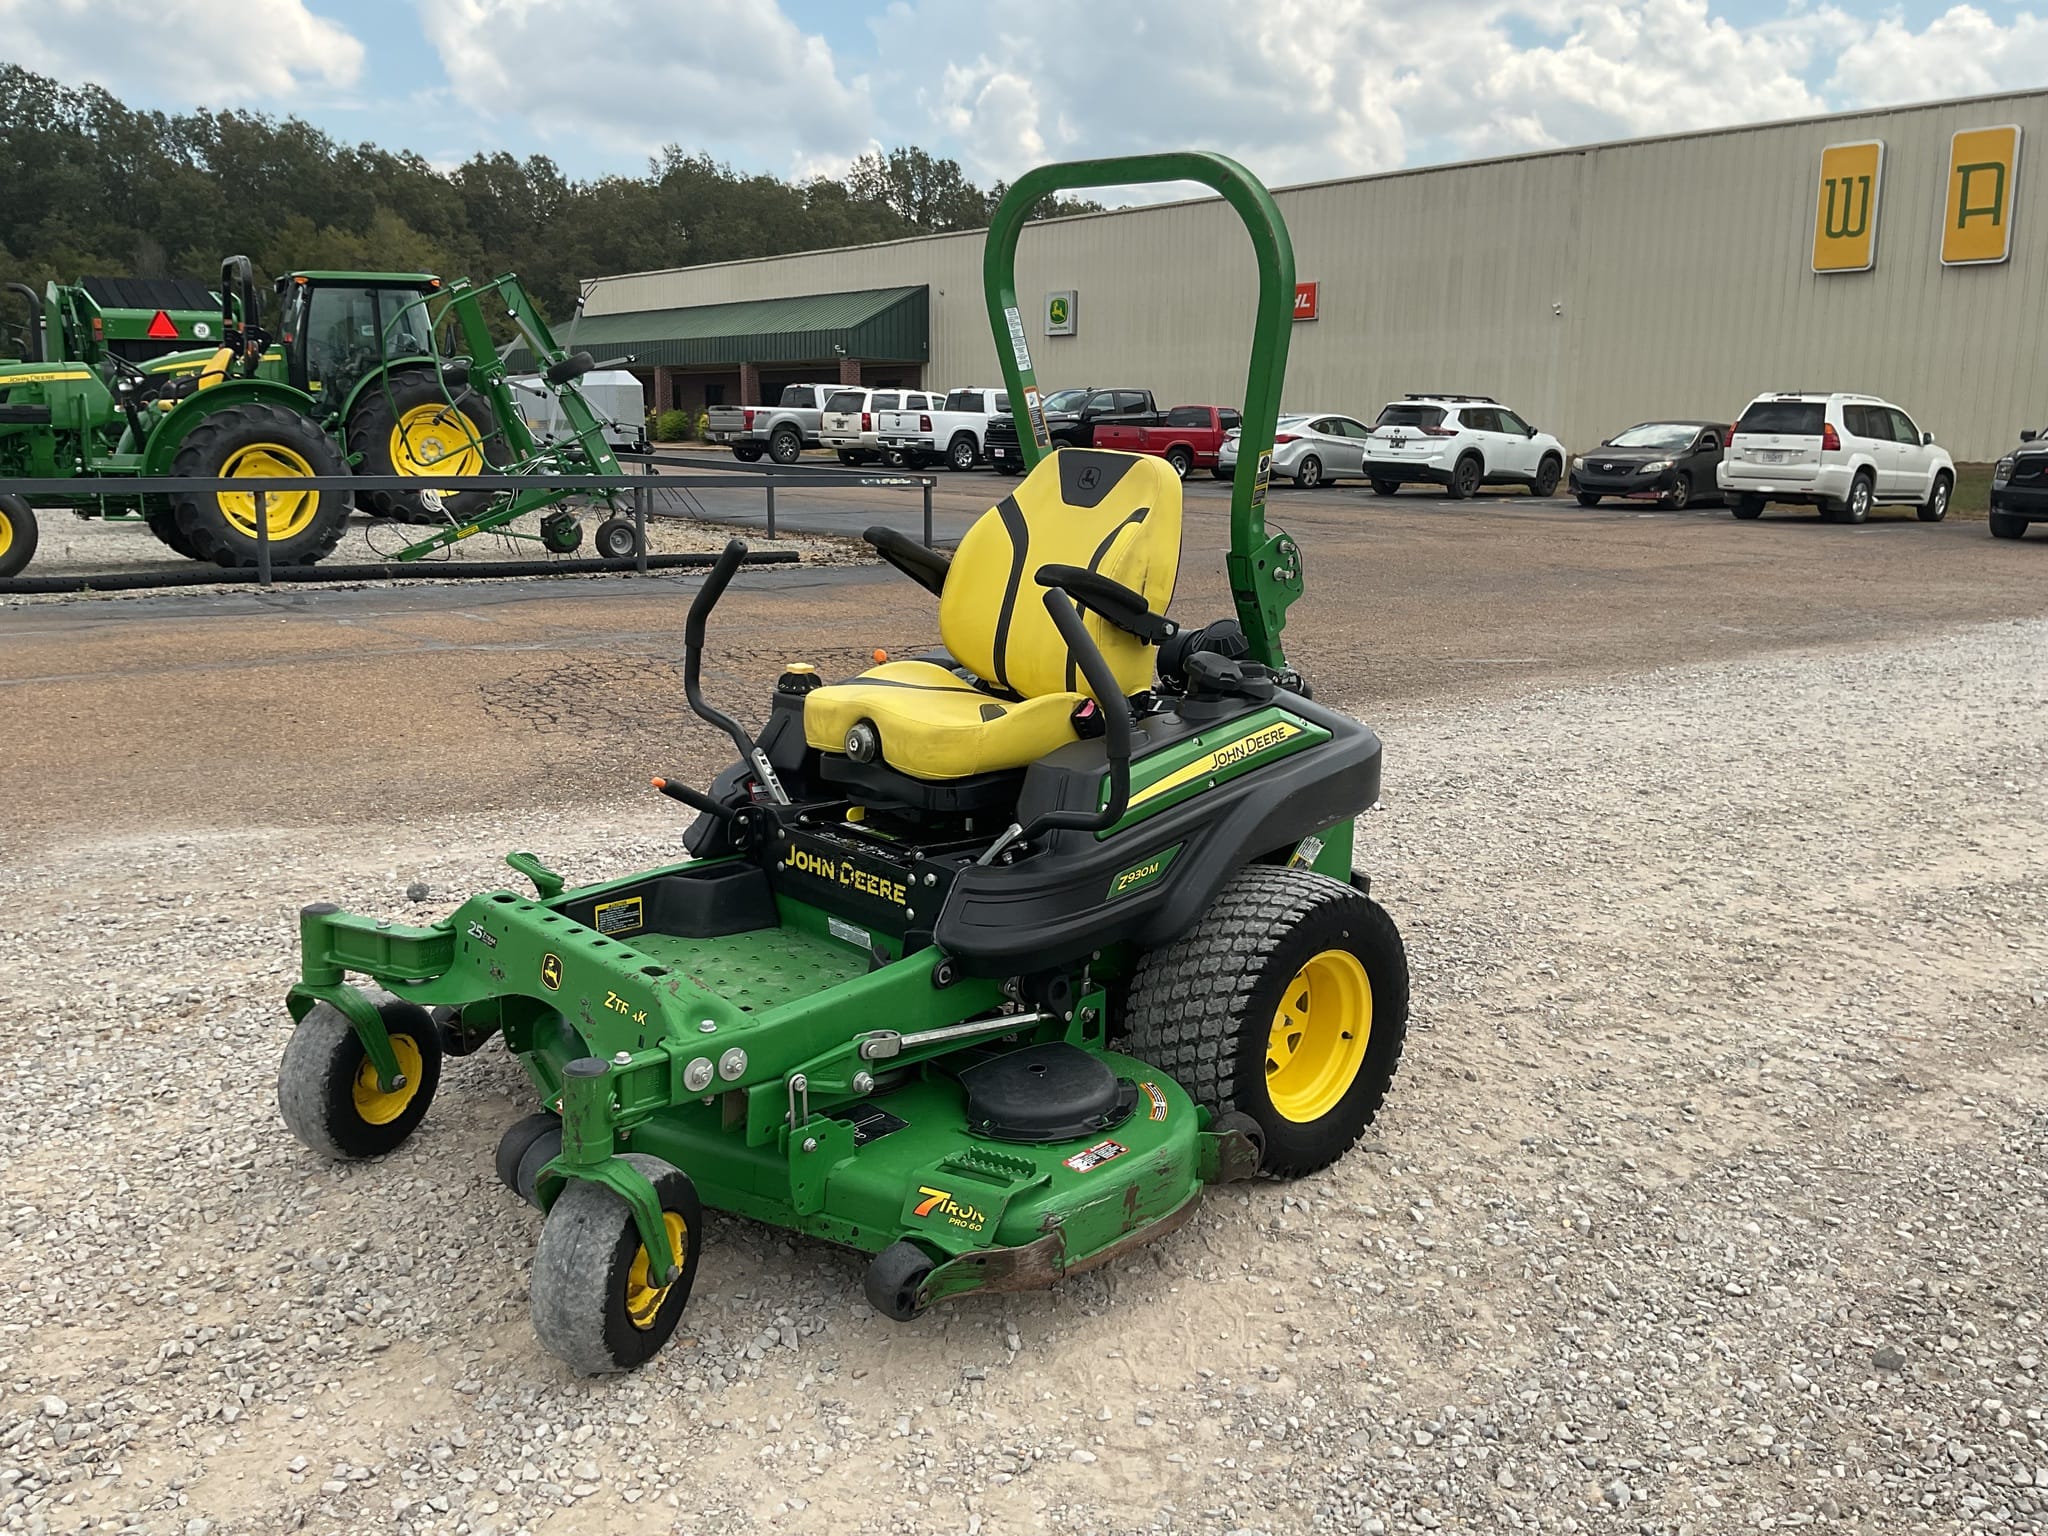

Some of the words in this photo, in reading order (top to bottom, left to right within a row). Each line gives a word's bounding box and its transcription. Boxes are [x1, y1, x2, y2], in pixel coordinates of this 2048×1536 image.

[1825, 176, 1870, 239] W
[1957, 161, 2005, 230] A
[1212, 744, 1245, 769] JOHN
[1246, 726, 1286, 752] DEERE
[785, 843, 835, 880] JOHN
[840, 861, 907, 906] DEERE
[1117, 862, 1159, 891] Z930M
[467, 920, 484, 939] 25
[948, 1217, 968, 1228] PRO
[968, 1222, 983, 1231] 60
